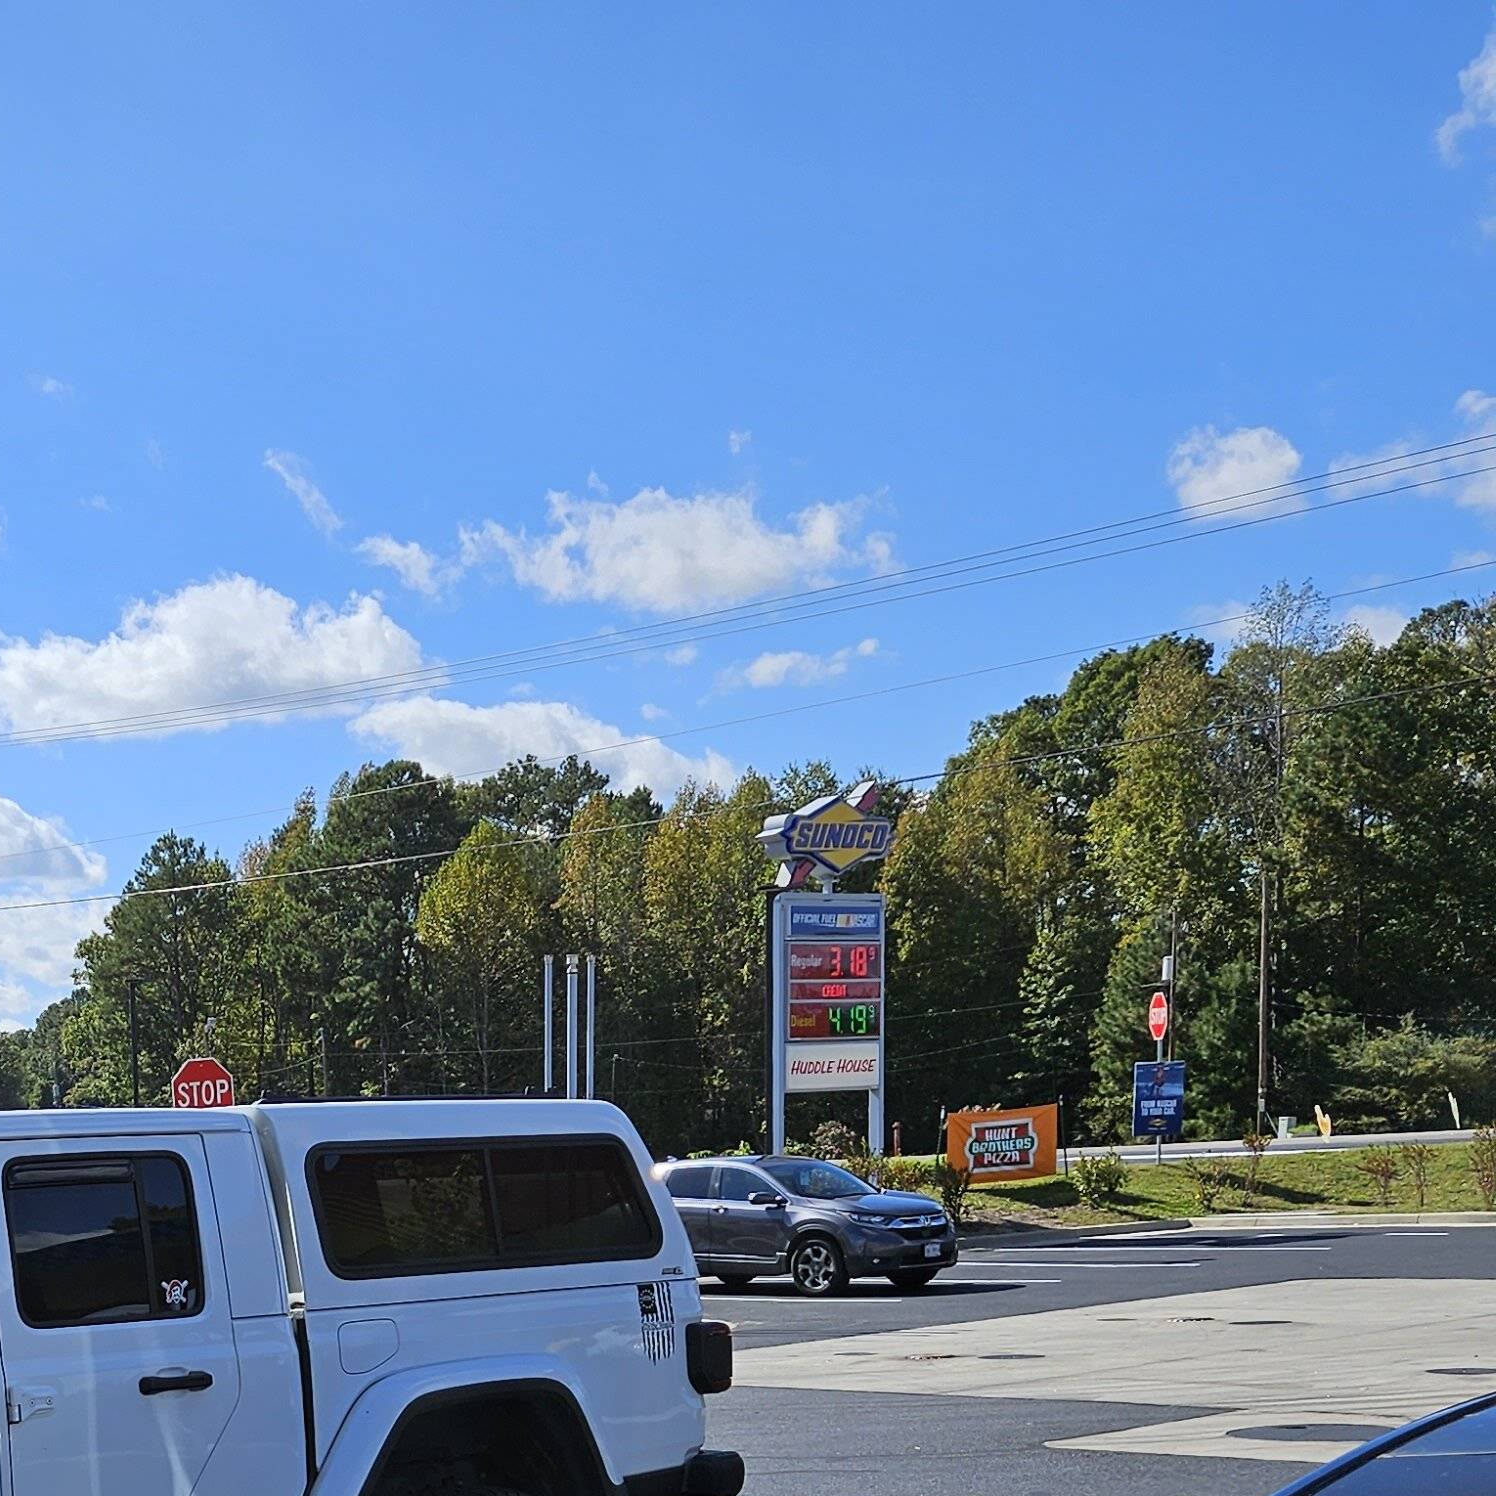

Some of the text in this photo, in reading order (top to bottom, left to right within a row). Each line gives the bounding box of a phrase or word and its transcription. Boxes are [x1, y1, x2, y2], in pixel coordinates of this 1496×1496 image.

[795, 823, 890, 848] SUNOCO
[791, 954, 822, 969] Regular
[830, 946, 867, 976] 3.18
[822, 984, 847, 997] CREDIT
[791, 1014, 816, 1027] Diesel
[828, 1005, 866, 1034] 4.19
[791, 1058, 877, 1075] HUDDLE HOUSE
[177, 1079, 229, 1107] STOP
[985, 1127, 1018, 1141] HUNT
[971, 1138, 1032, 1153] BROTHERS
[983, 1152, 1020, 1164] PIZZA
